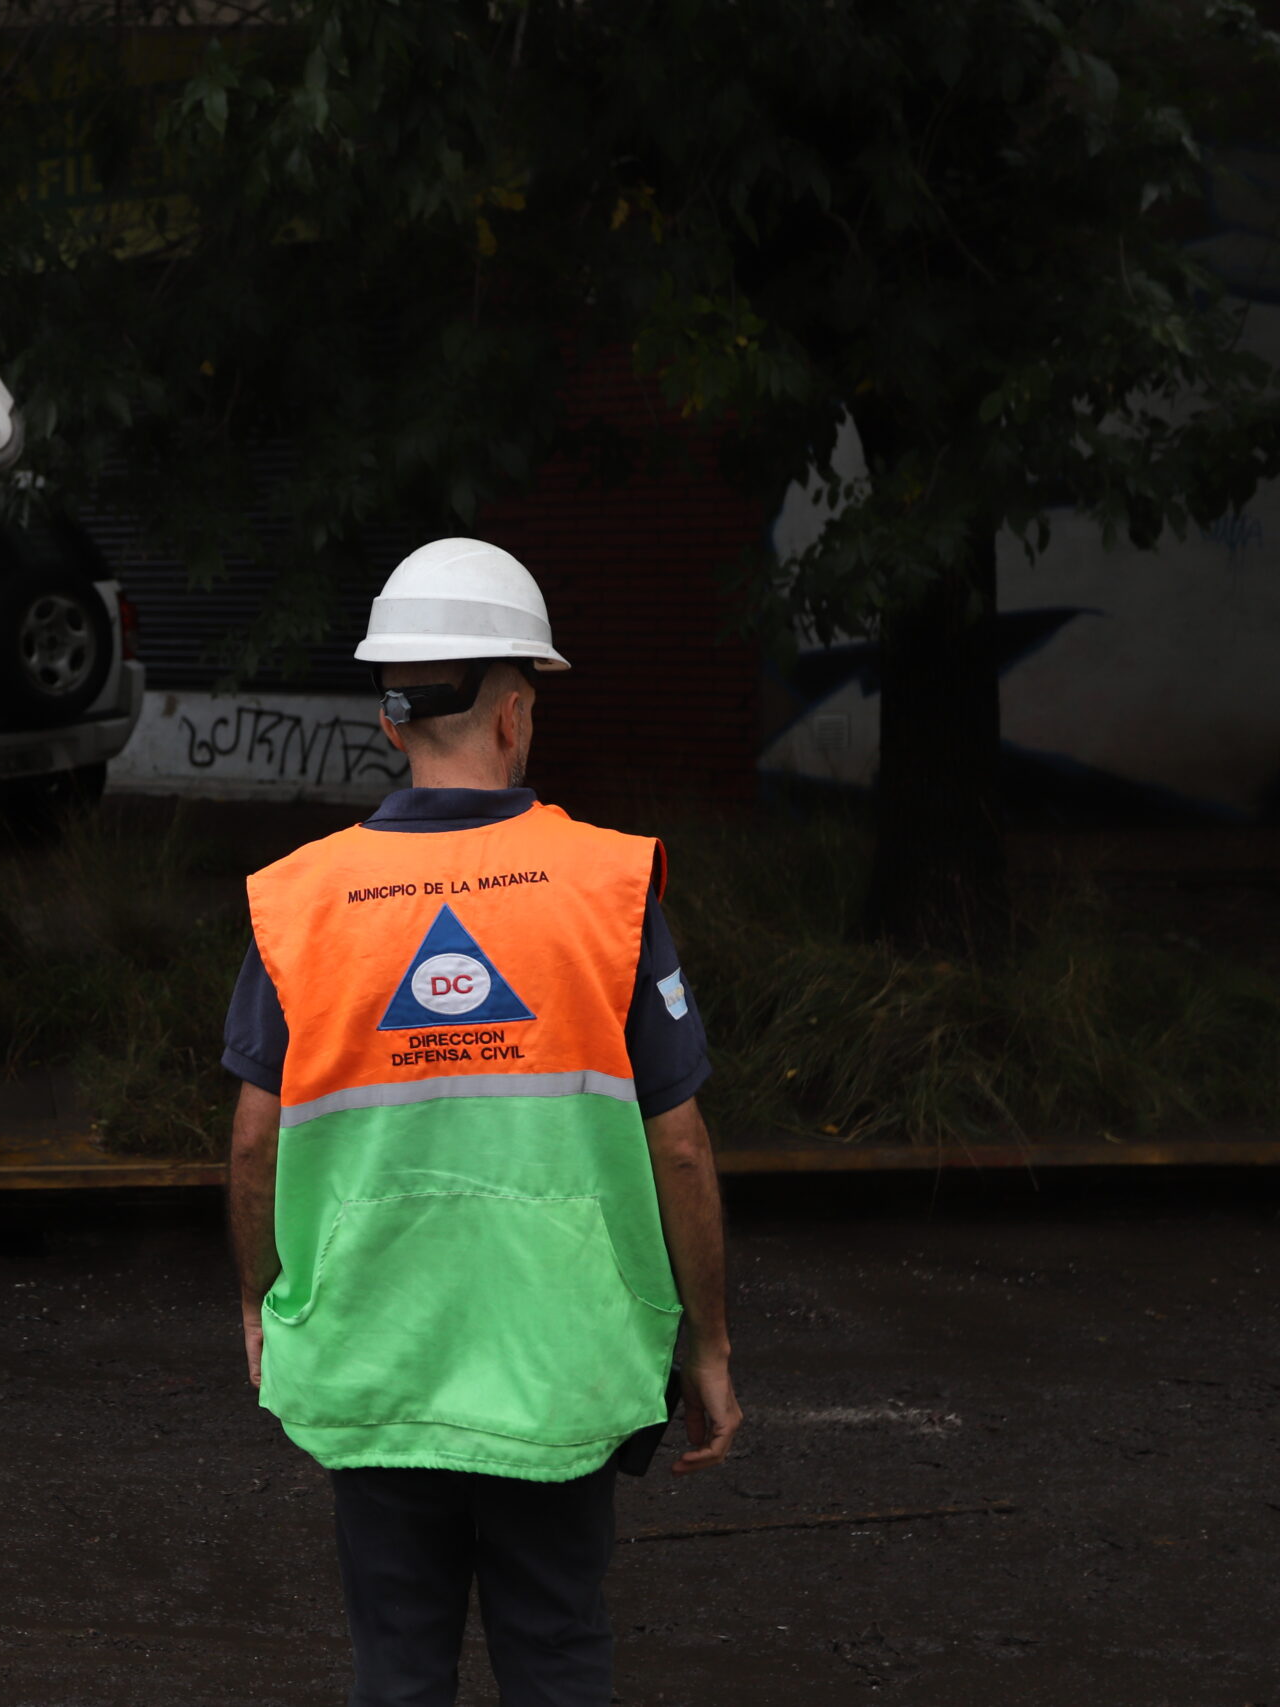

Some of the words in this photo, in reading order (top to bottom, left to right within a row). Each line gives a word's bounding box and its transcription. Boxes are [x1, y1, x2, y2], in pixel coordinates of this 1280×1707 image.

[348, 883, 417, 904] MUNICIPIO
[423, 882, 444, 895] DE
[451, 880, 471, 894] LA
[478, 870, 549, 891] MATANZA
[430, 974, 474, 996] DC
[408, 1030, 505, 1049] DIRECCION
[391, 1047, 472, 1067] DEFENSA
[480, 1045, 525, 1061] CIVIL
